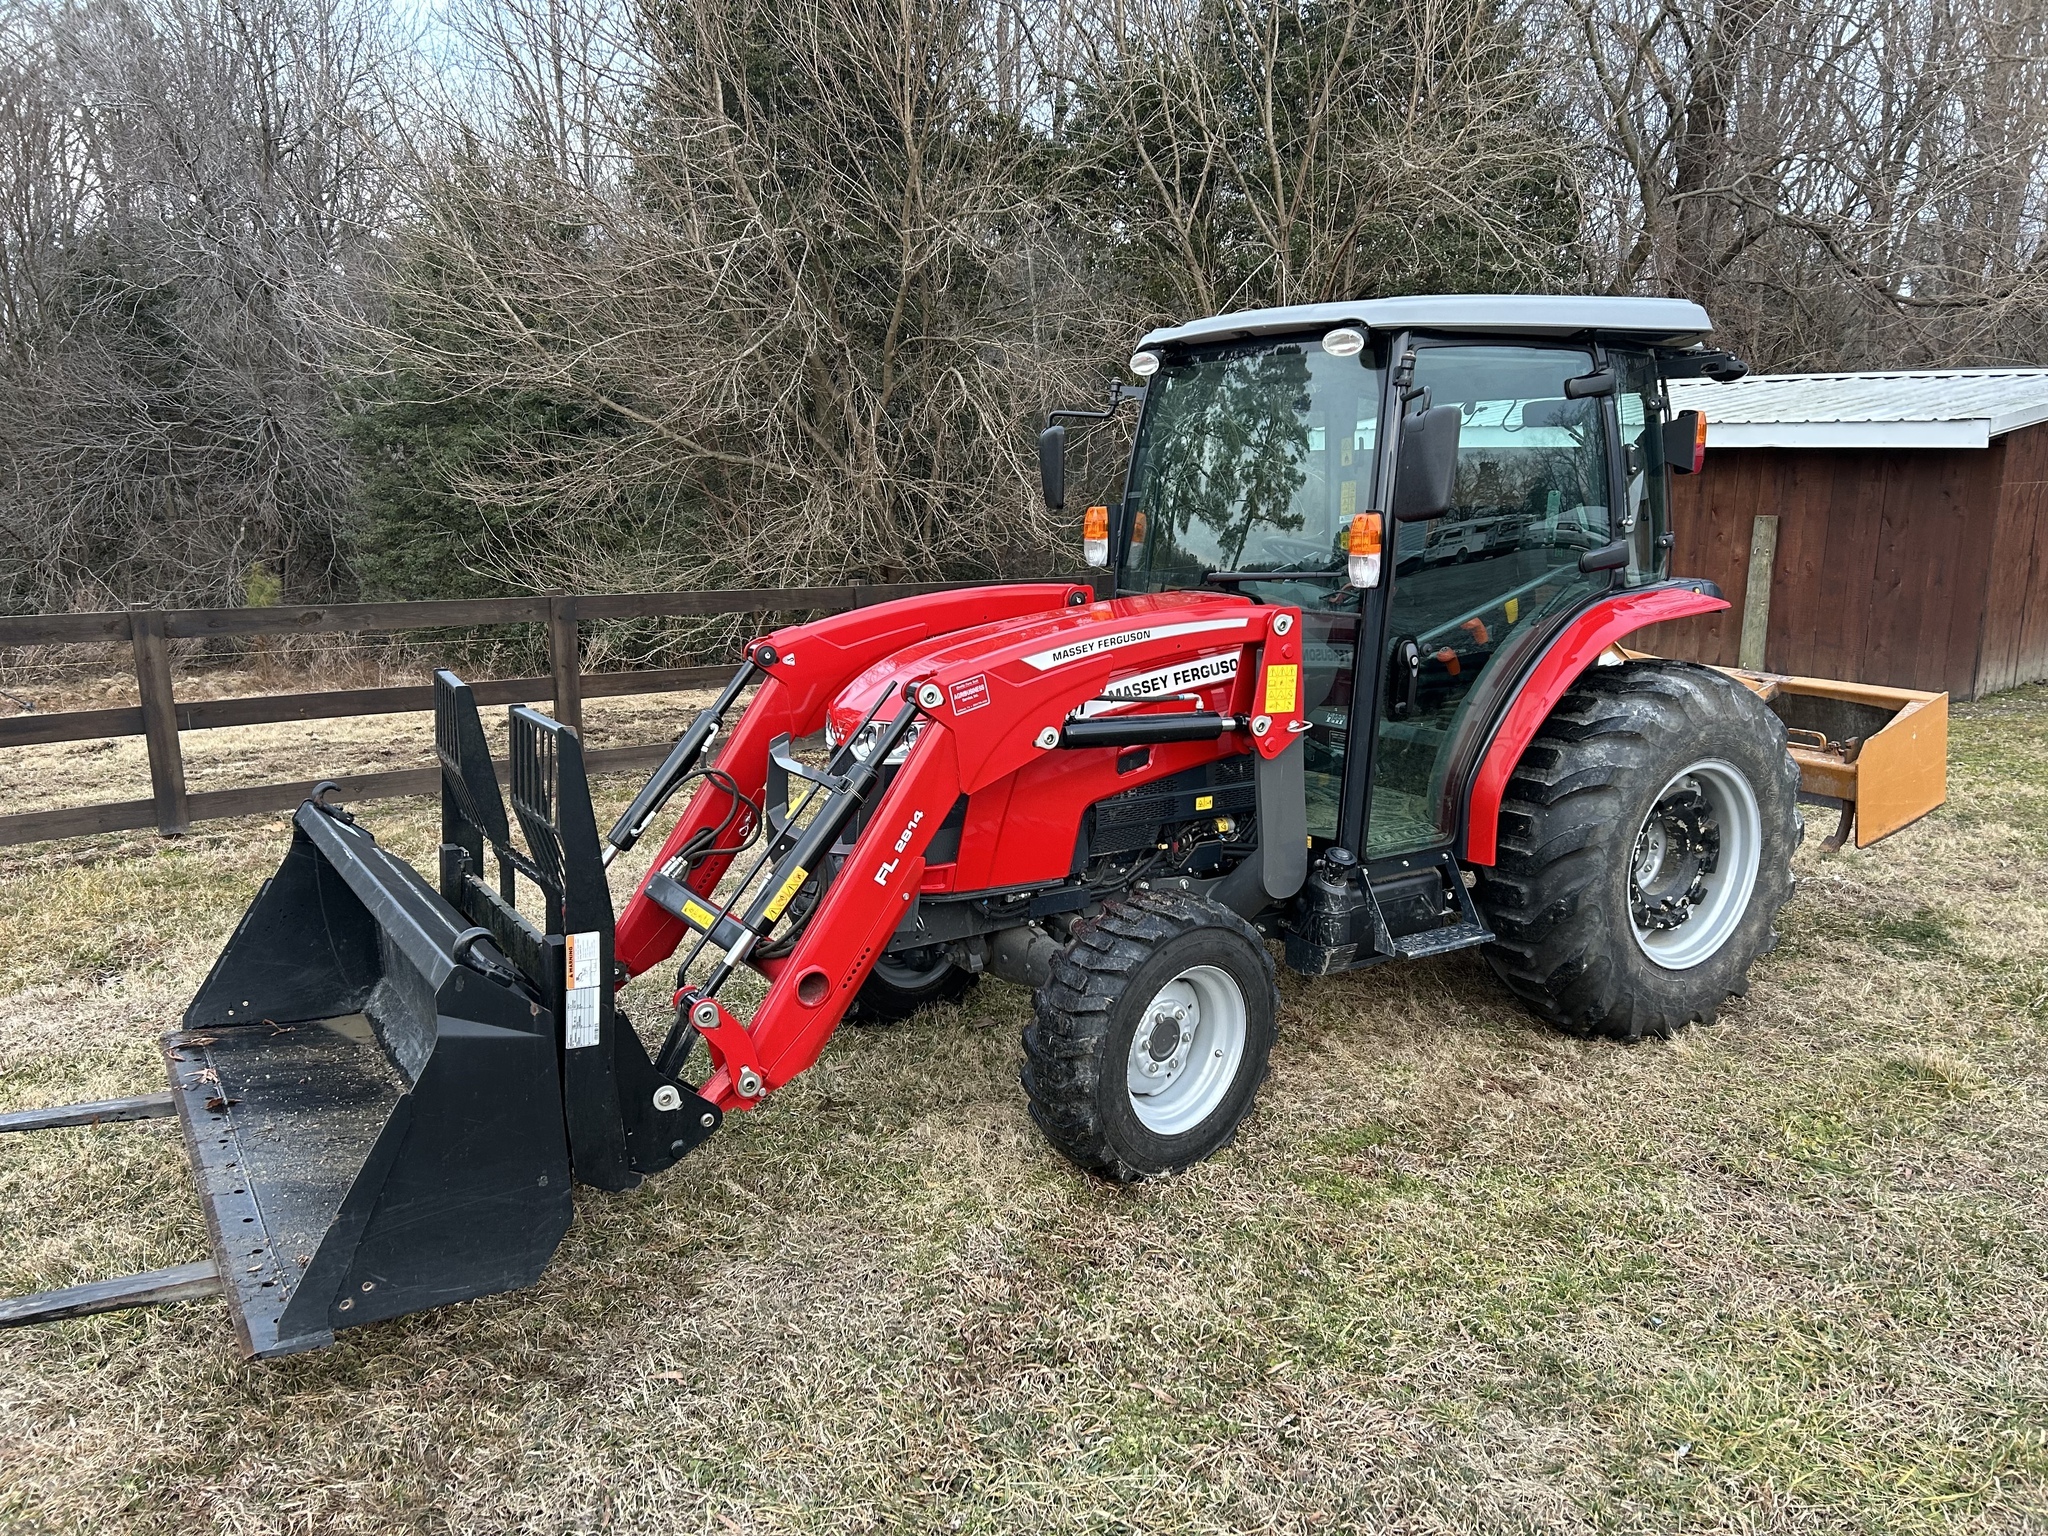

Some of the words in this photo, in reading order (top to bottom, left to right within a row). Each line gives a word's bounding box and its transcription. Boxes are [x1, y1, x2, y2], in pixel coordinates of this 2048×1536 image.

[1052, 642, 1095, 661] MASSEY
[1097, 630, 1151, 648] FERGUSON
[1174, 658, 1238, 685] FERGUSO
[873, 857, 900, 886] FL
[894, 810, 924, 854] 2814
